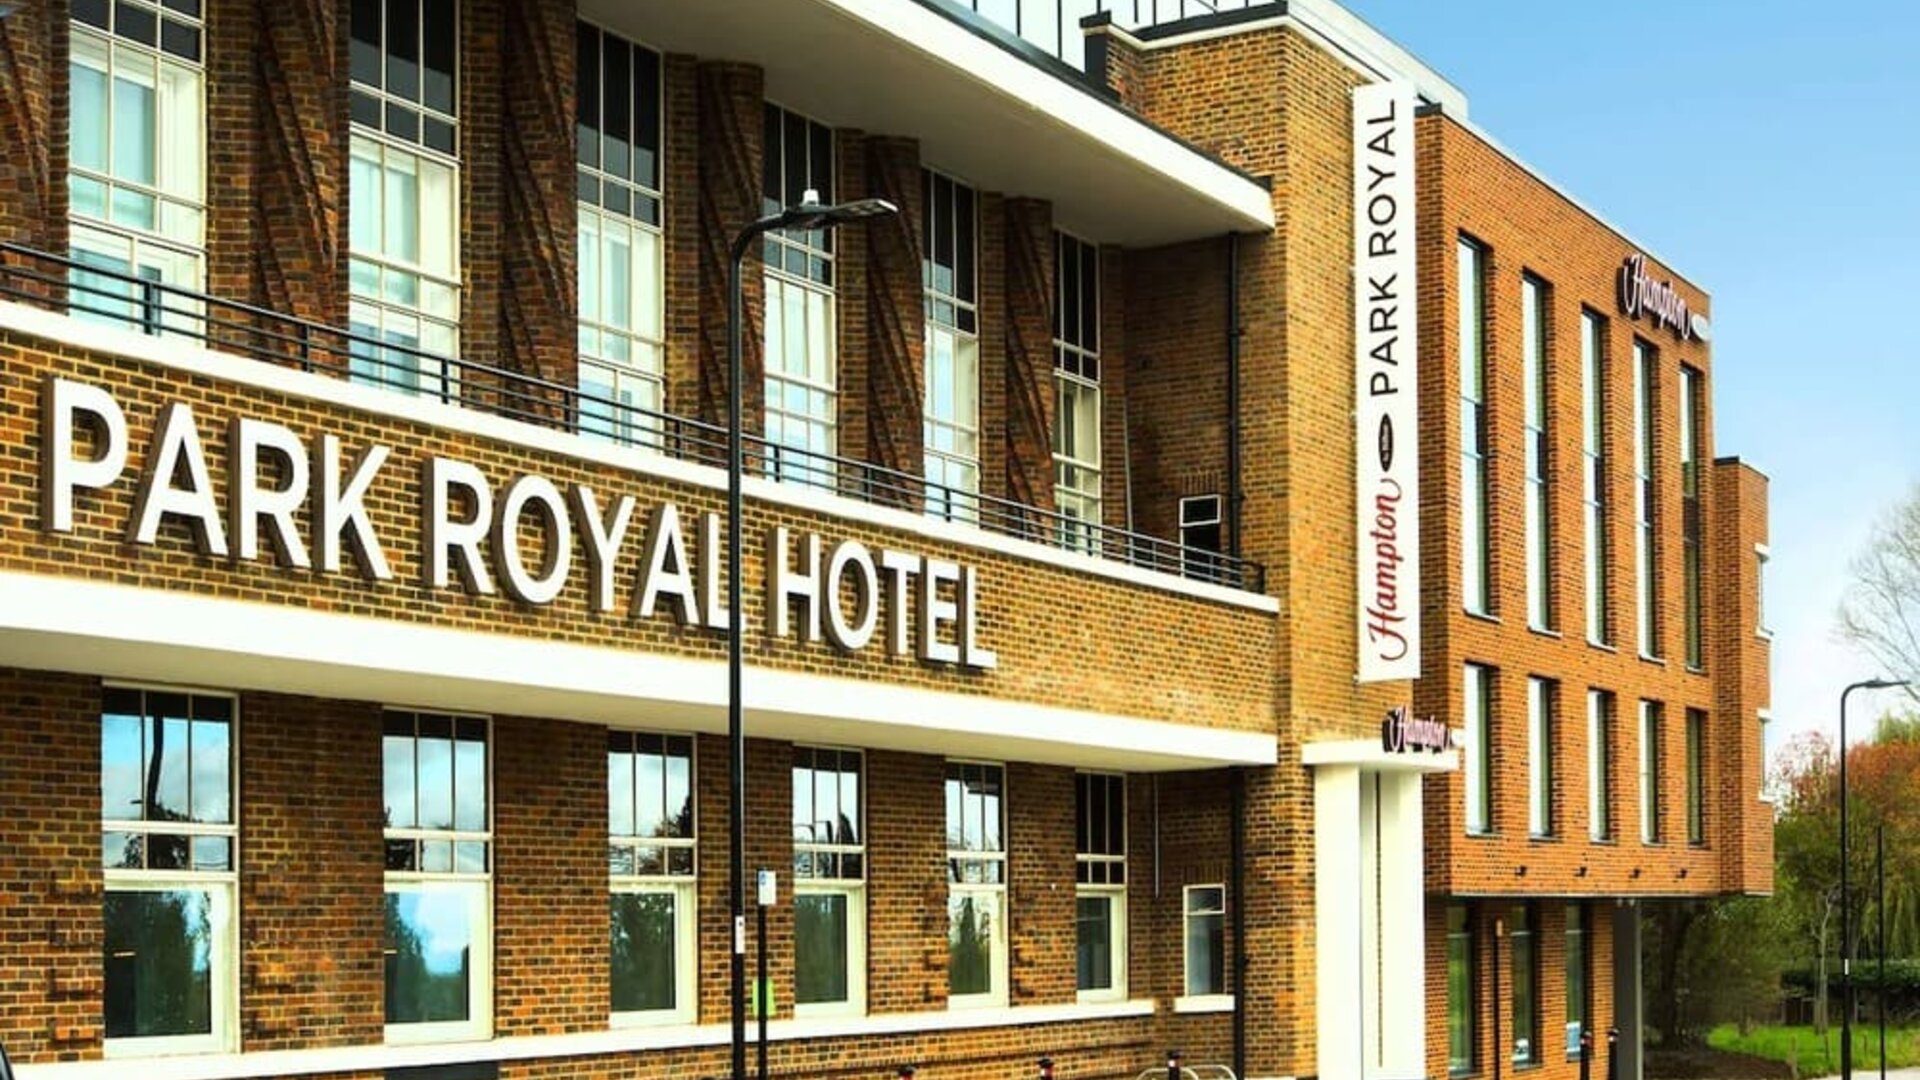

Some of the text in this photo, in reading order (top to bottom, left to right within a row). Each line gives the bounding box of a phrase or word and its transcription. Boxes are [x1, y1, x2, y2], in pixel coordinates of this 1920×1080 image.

[1366, 98, 1399, 396] PARK ROYAL
[46, 377, 996, 669] PARK ROYAL HOTEL
[1366, 477, 1408, 661] Hampton
